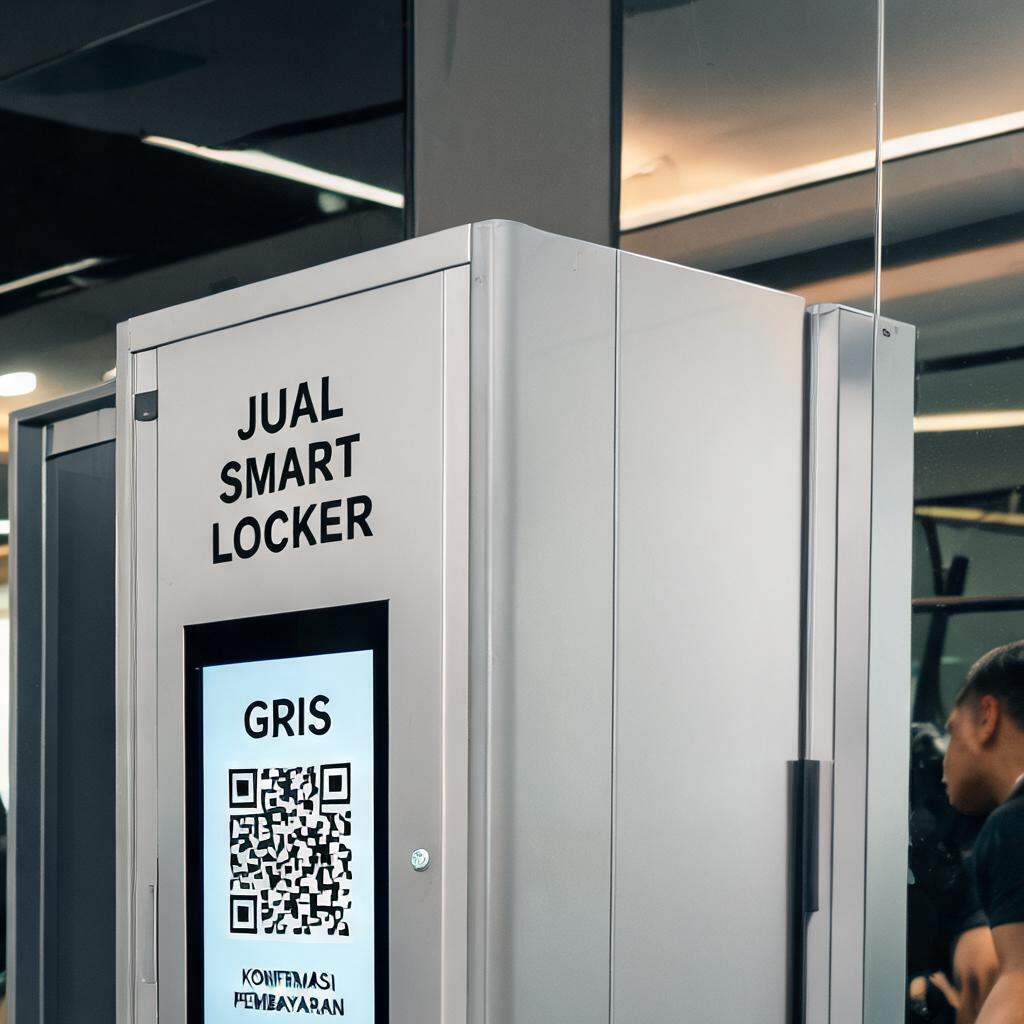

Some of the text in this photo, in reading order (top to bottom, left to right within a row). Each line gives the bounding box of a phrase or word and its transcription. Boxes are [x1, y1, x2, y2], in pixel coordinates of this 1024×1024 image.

[237, 375, 344, 441] JUAL
[219, 432, 361, 504] SMART
[212, 494, 374, 565] LOCKER
[243, 694, 332, 739] GRIS
